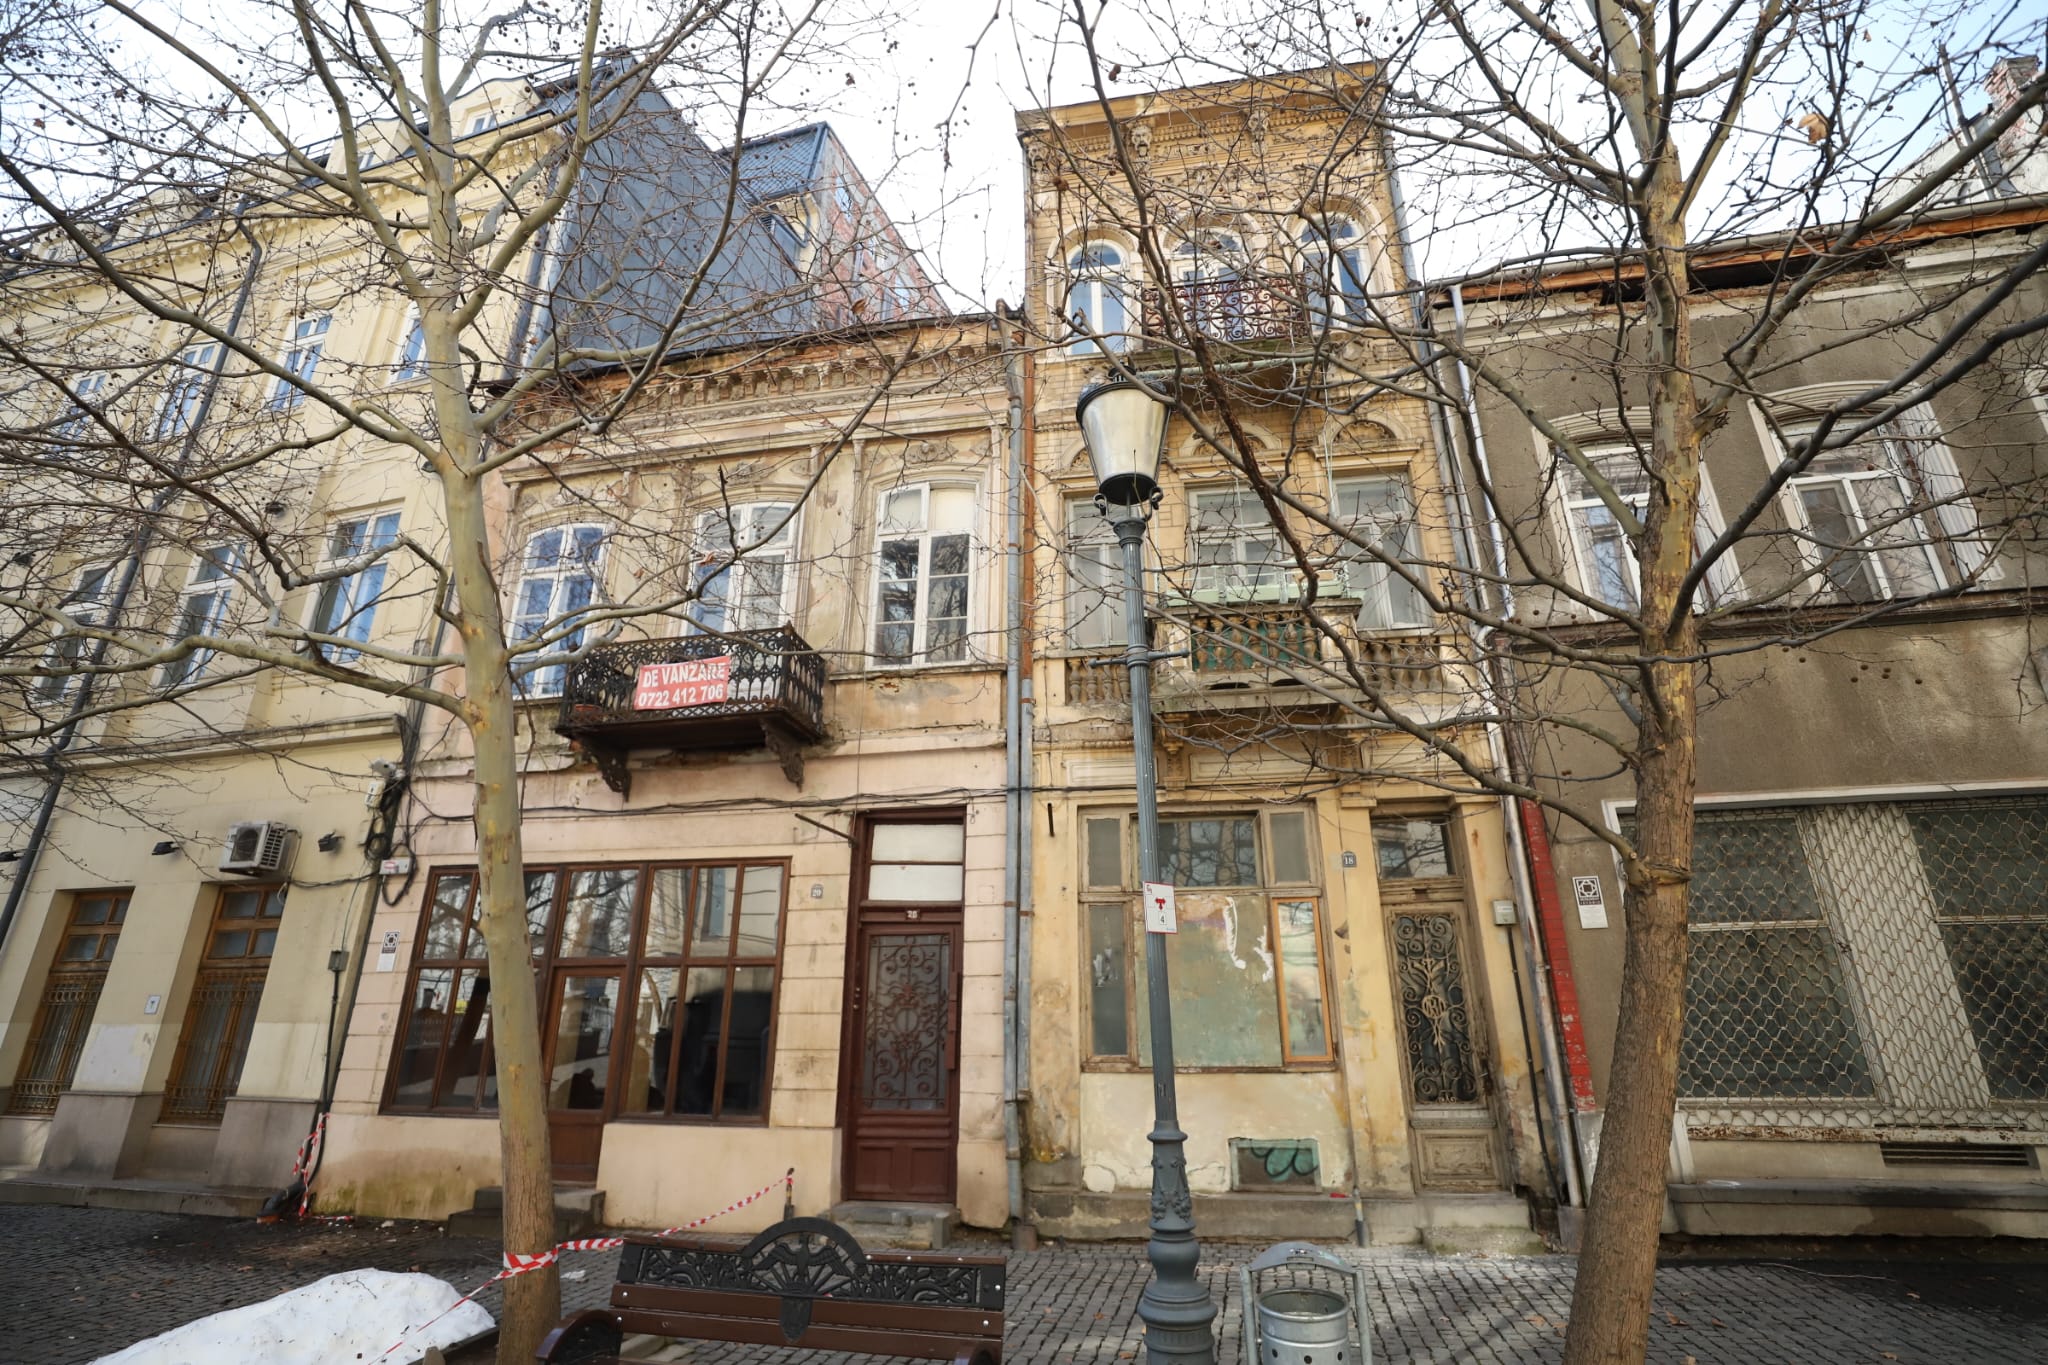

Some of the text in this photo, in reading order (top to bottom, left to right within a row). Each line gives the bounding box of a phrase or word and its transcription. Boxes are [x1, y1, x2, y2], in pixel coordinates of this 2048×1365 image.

[643, 663, 726, 687] DE VANZARE
[638, 685, 723, 707] 0722 412 706
[1345, 856, 1354, 865] 18
